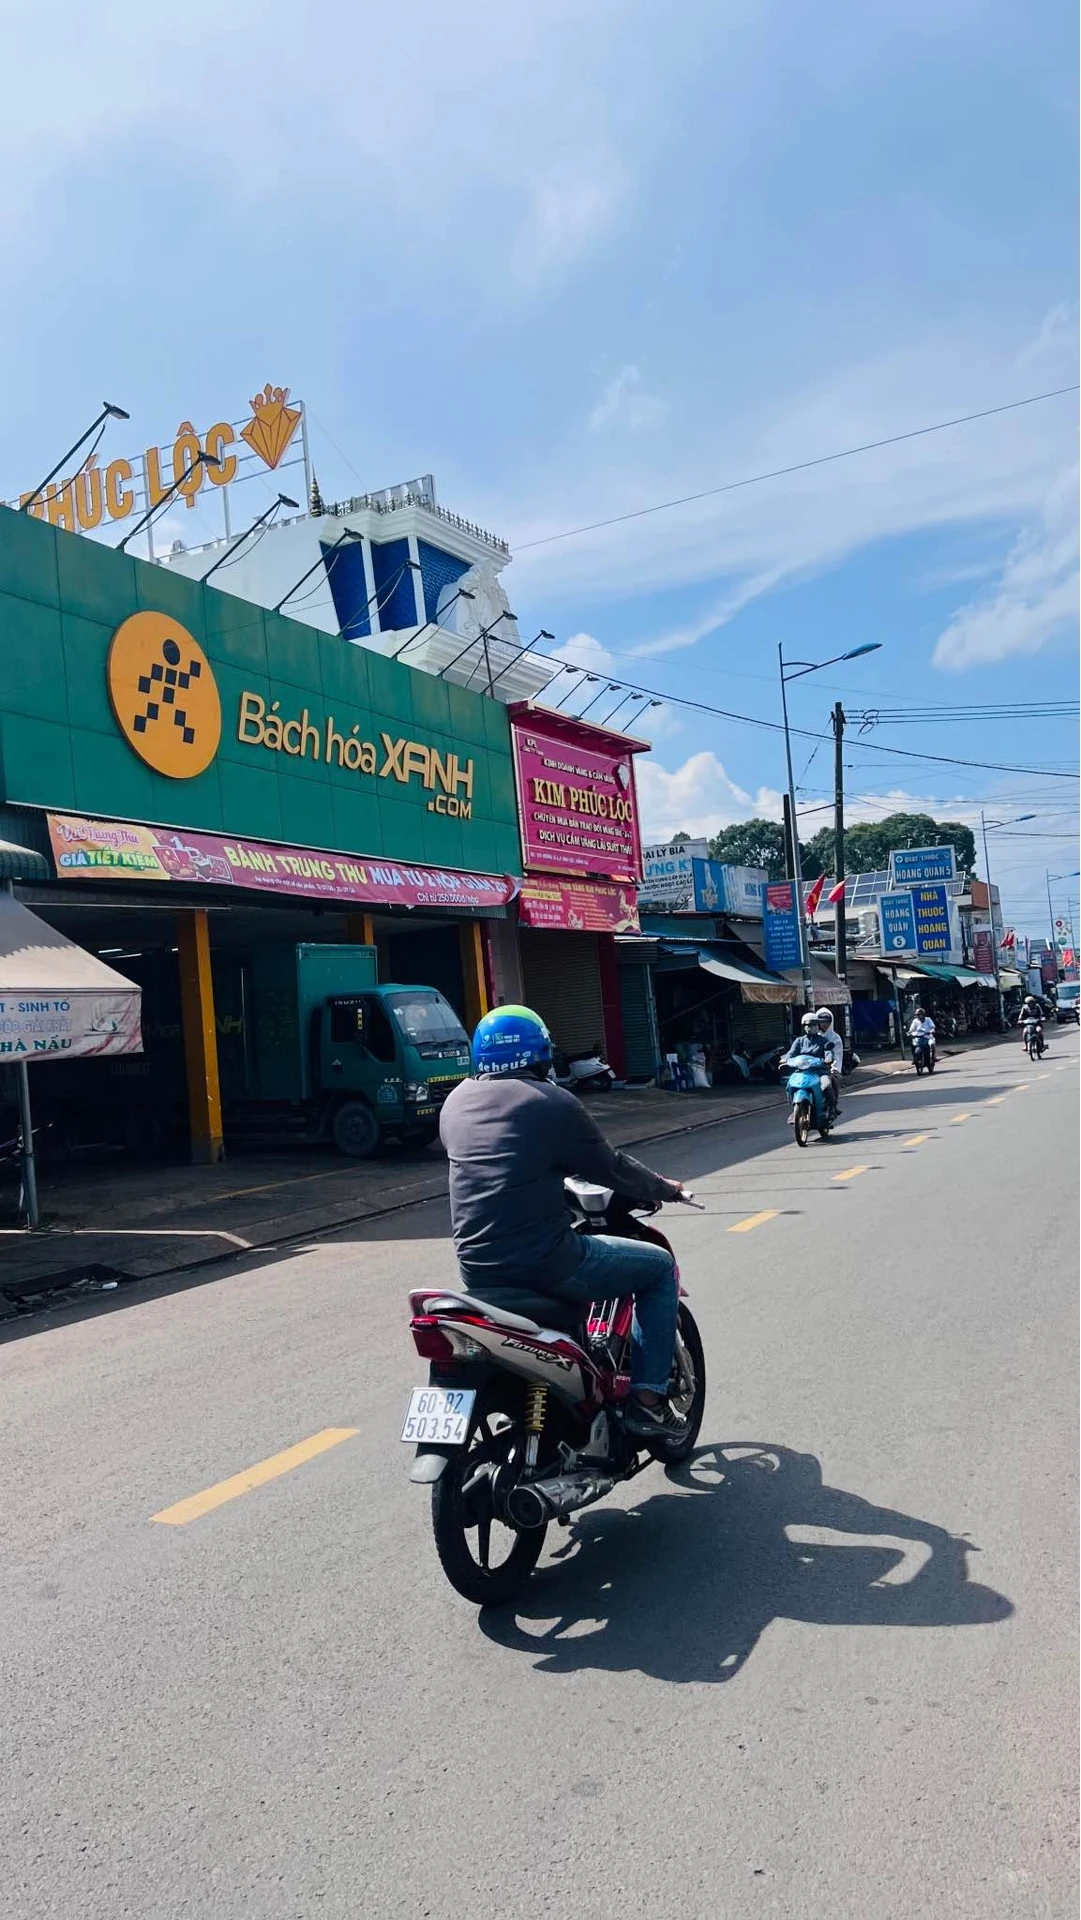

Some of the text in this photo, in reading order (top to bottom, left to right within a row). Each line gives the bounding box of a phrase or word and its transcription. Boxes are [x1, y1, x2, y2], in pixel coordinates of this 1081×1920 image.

[19, 421, 237, 532] PHÚC LỘC
[239, 691, 473, 799] Bách hóa XANH
[427, 795, 472, 820] .COM
[533, 777, 633, 826] KIM PHÚC LỘC
[539, 829, 555, 843] DỊCH
[60, 846, 160, 870] GIÁ TIẾT KIỆM
[223, 843, 279, 874] BÁNH
[276, 854, 335, 882] TRUNG
[335, 862, 368, 886] THU
[368, 866, 405, 886] MUA
[643, 846, 685, 861] ẠI LÝ BIA
[896, 937, 902, 946] 5
[18, 1001, 50, 1013] SINH
[53, 997, 70, 1012] TỐ
[0, 1034, 73, 1053] HÀ NẤU
[478, 1061, 490, 1072] de
[491, 1058, 528, 1072] heus
[418, 1392, 464, 1415] 60-B2
[405, 1417, 463, 1440] 503.54
